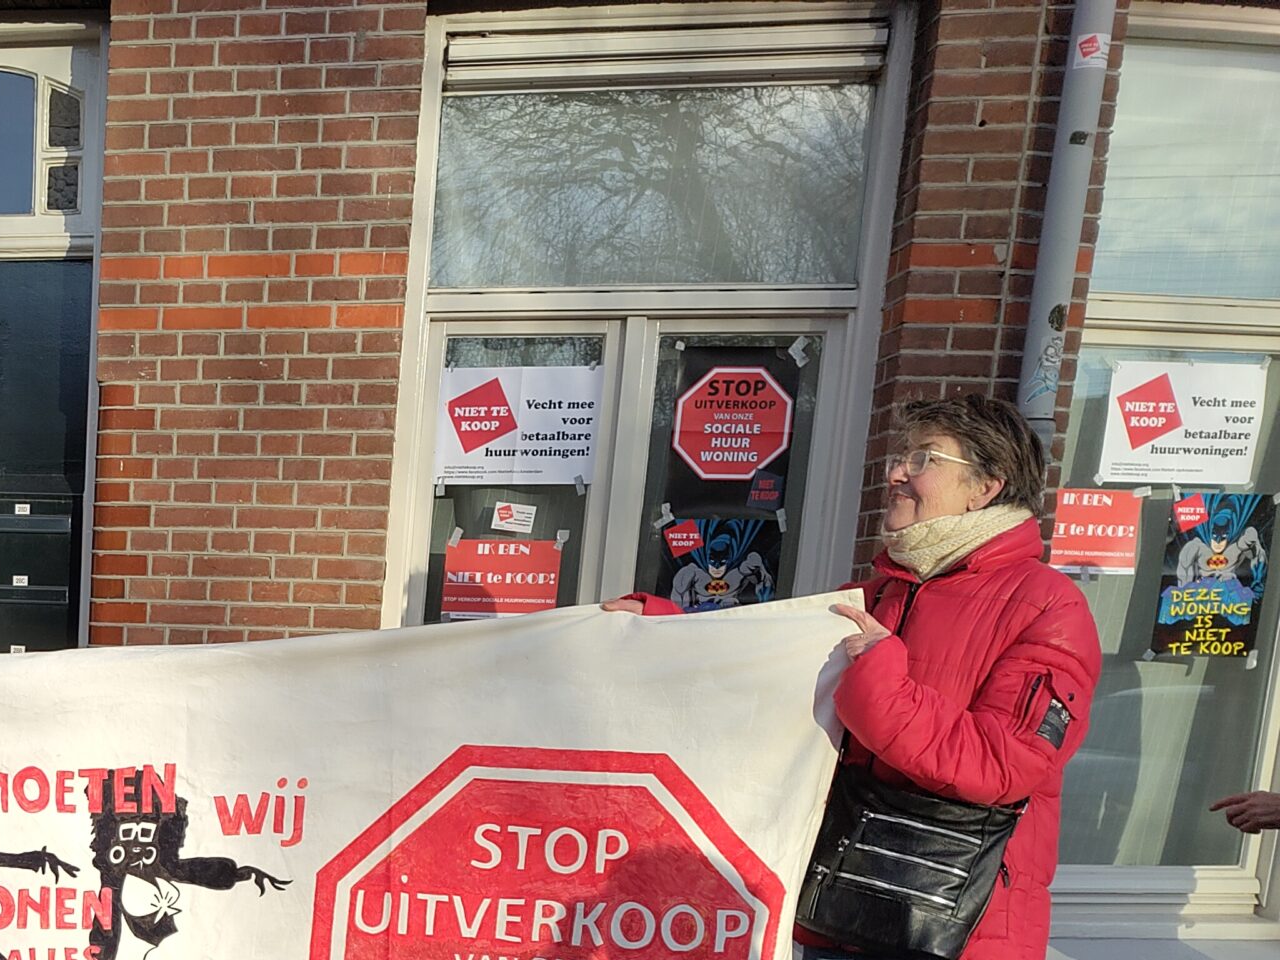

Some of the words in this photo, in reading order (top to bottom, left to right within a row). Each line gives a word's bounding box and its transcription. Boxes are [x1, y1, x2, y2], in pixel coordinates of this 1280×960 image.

[707, 380, 767, 397] STOP
[526, 399, 563, 410] Vecht
[567, 401, 595, 409] mee
[694, 400, 777, 410] UITVERKOOP
[1125, 401, 1156, 413] NIET
[1159, 402, 1175, 413] TE
[1192, 396, 1227, 408] Vecht
[1230, 399, 1256, 408] mee
[454, 406, 487, 418] NIET
[491, 405, 509, 416] TE
[713, 413, 731, 421] VAN
[732, 413, 754, 421] ONZE
[562, 417, 593, 425] voor
[1130, 416, 1166, 427] KOOP
[1224, 415, 1254, 424] voor
[460, 421, 500, 431] KOOP
[703, 423, 761, 434] SOCIALE
[521, 431, 591, 441] betaalbare
[1184, 429, 1251, 440] betaalbare
[711, 437, 750, 448] HUUR
[485, 446, 590, 459] huurwoningen!
[700, 451, 758, 462] WONING
[1150, 444, 1248, 459] huurwoningen!
[1062, 492, 1080, 505] IK
[1082, 493, 1113, 507] BEN
[1069, 523, 1085, 536] te
[1087, 523, 1135, 537] KOOP!
[477, 543, 495, 555] IK
[498, 543, 531, 555] BEN
[446, 571, 484, 583] NIET
[487, 572, 502, 584] te
[505, 572, 556, 585] KOOP!
[1171, 588, 1224, 603] DEZE
[1170, 603, 1251, 615] WONING
[1194, 615, 1213, 628] IS
[1185, 628, 1232, 641] NIET
[1168, 642, 1192, 656] TE
[1200, 641, 1248, 656] KOOP.
[470, 823, 629, 874] STOP
